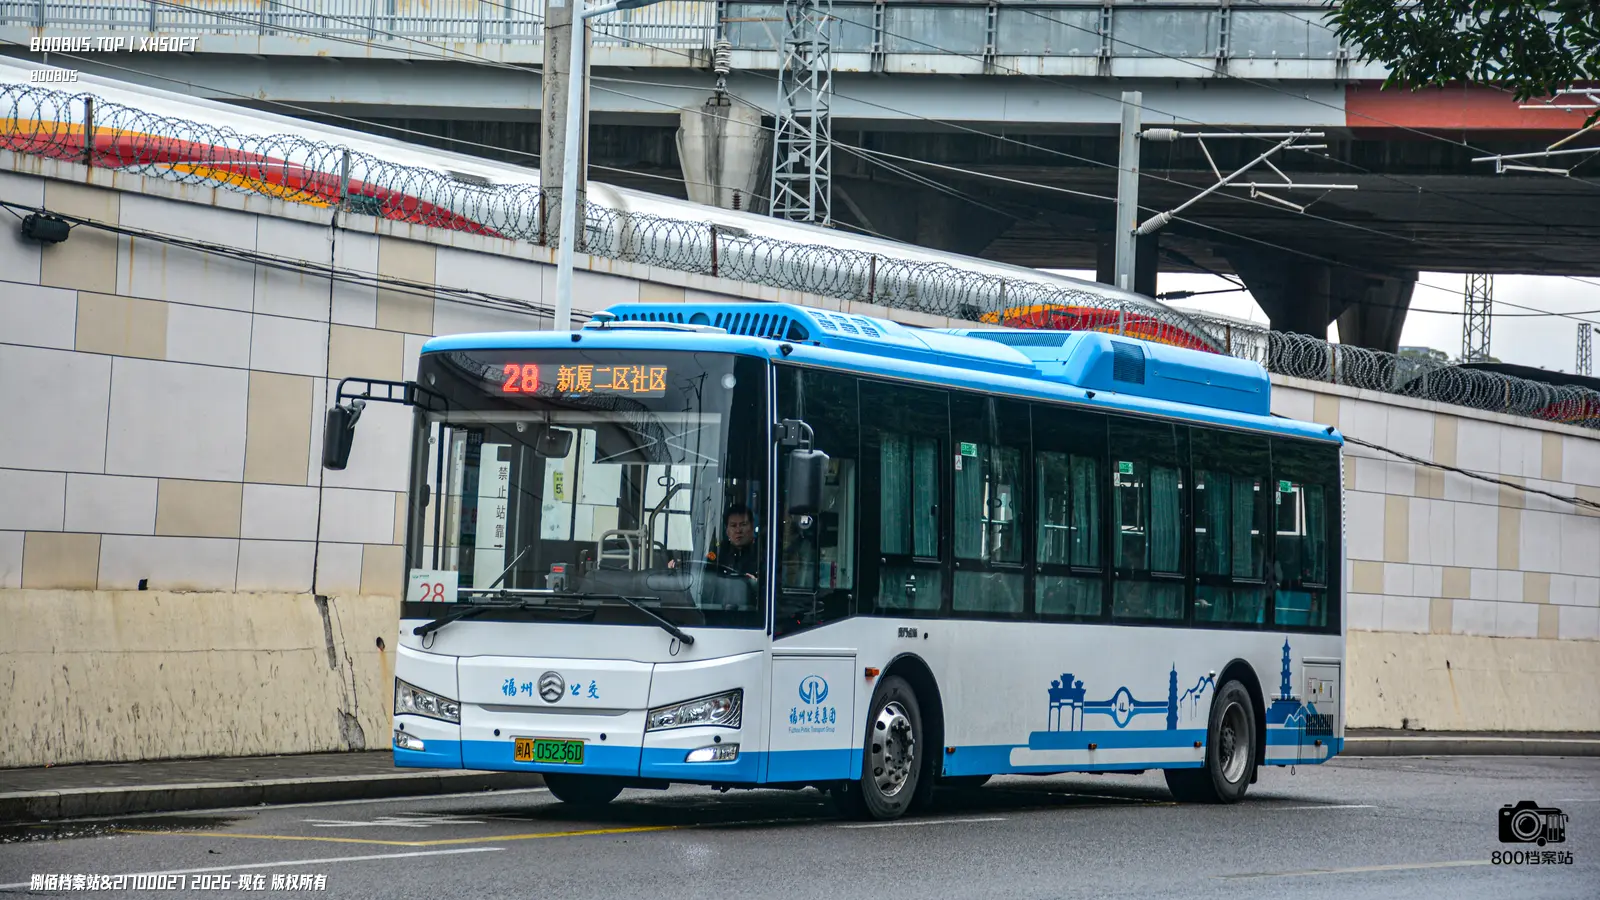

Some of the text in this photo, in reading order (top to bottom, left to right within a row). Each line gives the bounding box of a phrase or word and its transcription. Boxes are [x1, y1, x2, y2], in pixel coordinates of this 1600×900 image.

[503, 364, 539, 393] 28
[556, 365, 668, 393] 新厦二区社区
[420, 582, 445, 603] 28
[502, 678, 600, 699] 福州 公交
[789, 706, 836, 725] 福州公交集团
